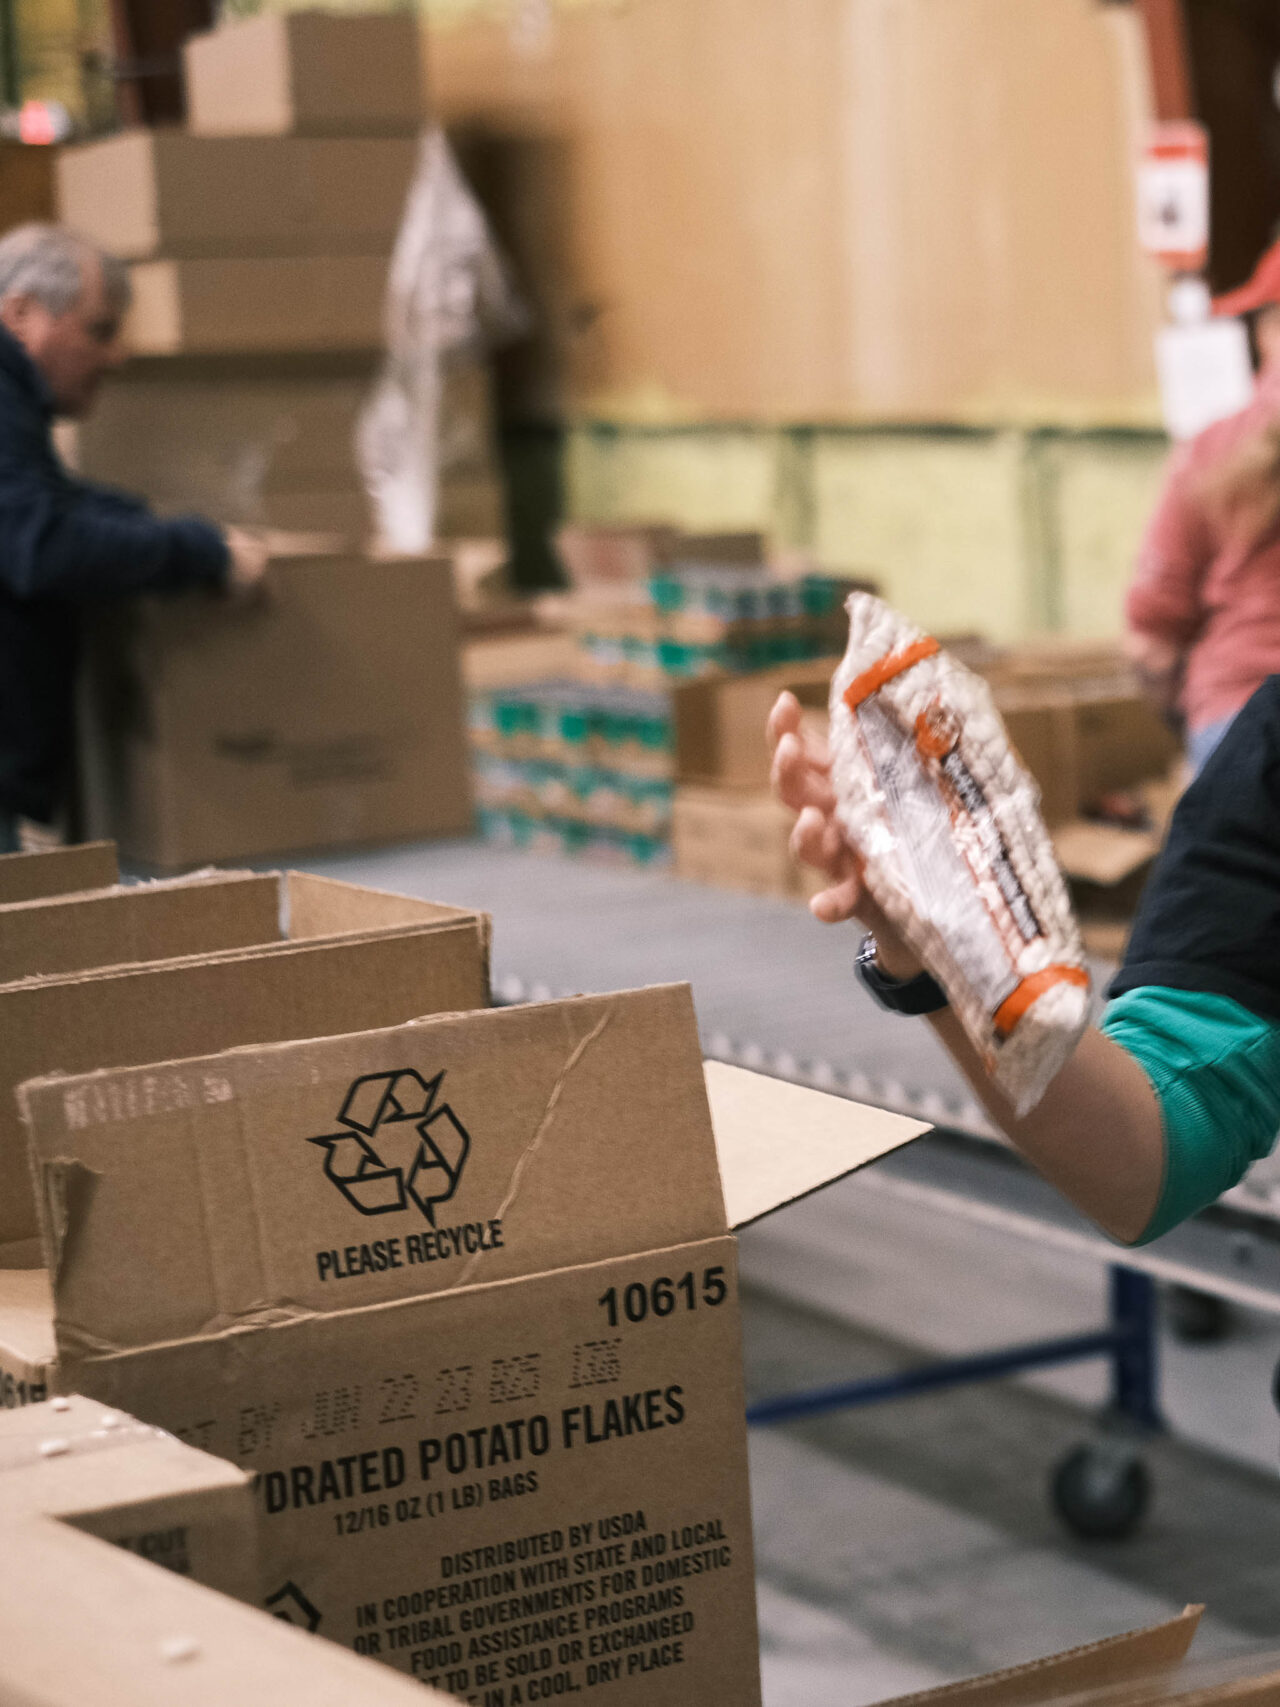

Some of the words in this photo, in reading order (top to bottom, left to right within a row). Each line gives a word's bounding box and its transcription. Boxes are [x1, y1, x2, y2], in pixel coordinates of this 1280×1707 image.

[316, 1238, 405, 1282] PLEASE
[405, 1218, 504, 1265] RECYCLE
[598, 1266, 727, 1327] 10615
[255, 1446, 405, 1515] DRATED
[418, 1414, 550, 1481] POTATO
[560, 1383, 686, 1450] FLAKES
[333, 1503, 390, 1536] 12/16
[395, 1496, 423, 1523] OZ
[426, 1490, 445, 1518] (1
[452, 1482, 484, 1510] LB)
[488, 1471, 538, 1502] BAGS
[355, 1603, 378, 1629] IN
[382, 1569, 517, 1622] COOPERATION
[520, 1557, 569, 1589] WITH
[573, 1543, 626, 1576] STATE
[630, 1533, 667, 1562] AND
[671, 1518, 727, 1551] LOCAL
[440, 1529, 564, 1579] DISTRIBUTED
[568, 1522, 594, 1548] BY
[598, 1509, 648, 1541] USDA
[352, 1632, 382, 1657] OR
[385, 1615, 455, 1650] TRIBAL
[459, 1579, 596, 1632] GOVERNMENTS
[599, 1568, 638, 1598] FOR
[642, 1545, 732, 1588] DOMESTIC
[410, 1641, 463, 1674] FOOD
[467, 1612, 579, 1660] ASSISTANCE
[584, 1585, 685, 1631] PROGRAMS
[444, 1668, 469, 1694] TO
[475, 1660, 500, 1687] BE
[504, 1647, 553, 1679] SOLD
[557, 1639, 584, 1665] OR
[588, 1610, 695, 1658] EXCHANGED
[484, 1688, 504, 1707] IN
[509, 1684, 523, 1707] A
[586, 1656, 623, 1687] DRY
[627, 1641, 686, 1676] PLACE
